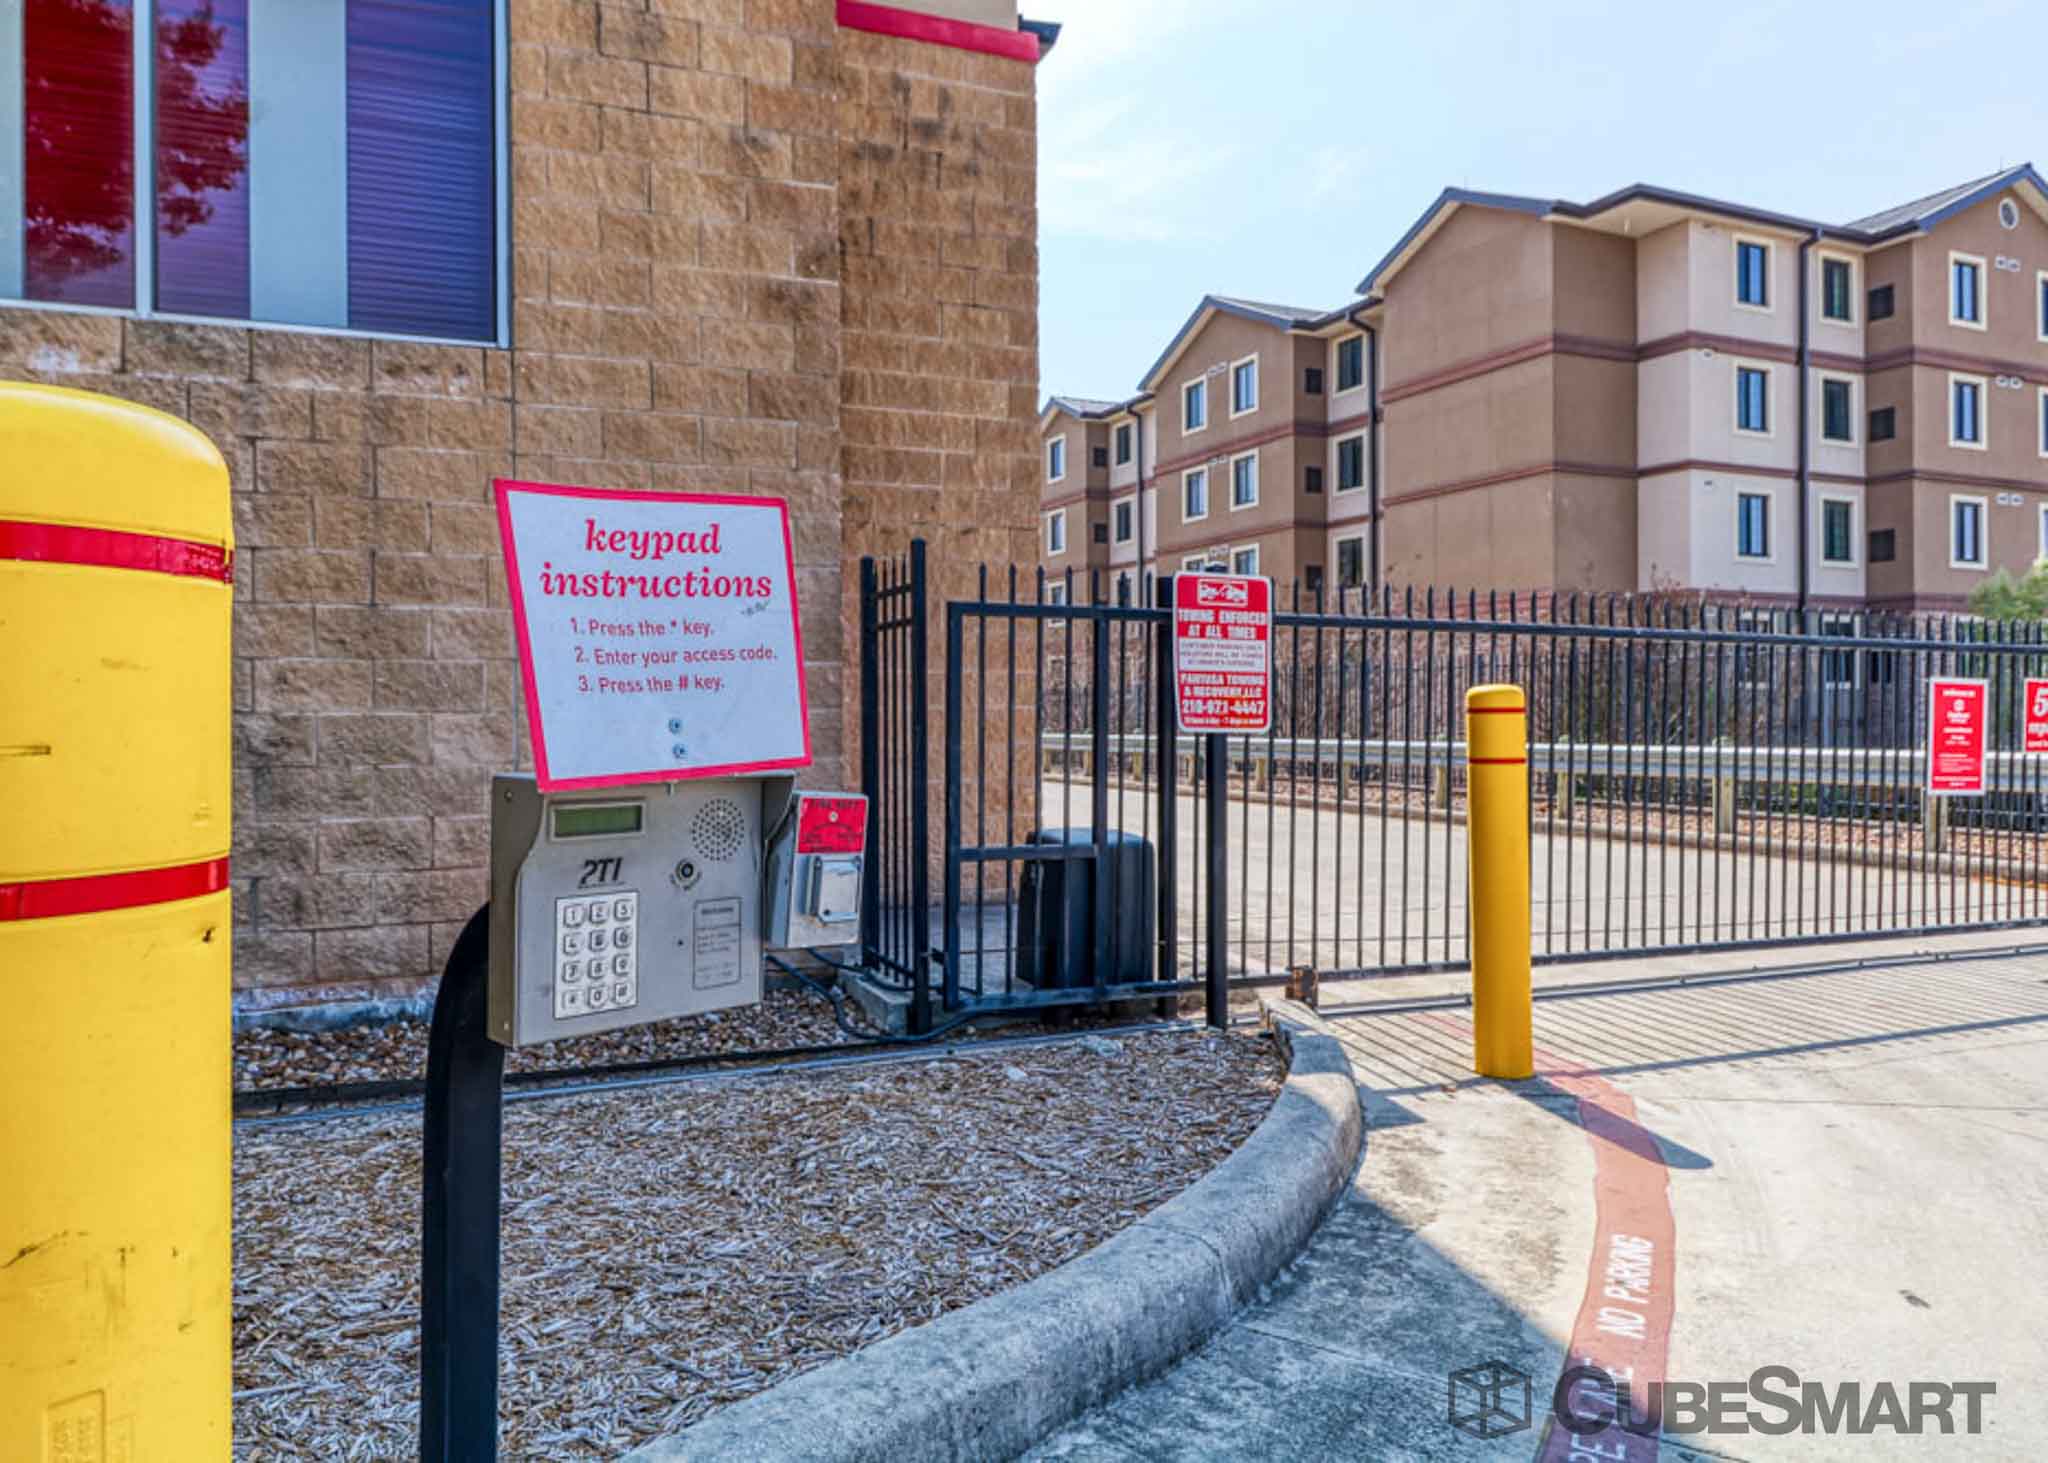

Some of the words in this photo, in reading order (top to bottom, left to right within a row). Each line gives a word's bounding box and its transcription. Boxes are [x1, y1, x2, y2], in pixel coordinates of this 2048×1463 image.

[585, 518, 722, 560] keypad
[539, 562, 773, 598] instructions
[570, 617, 584, 635] 1.
[589, 619, 635, 637] Press
[638, 619, 665, 635] the
[683, 619, 715, 639] key.
[574, 646, 590, 663] 2.
[594, 648, 636, 665] Enter
[641, 649, 677, 669] your
[683, 648, 735, 663] access
[739, 644, 777, 662] code.
[578, 674, 592, 693] 3.
[599, 676, 643, 694] Press
[646, 676, 672, 692] the
[678, 676, 689, 690] #
[694, 674, 724, 693] key.
[1603, 1232, 1656, 1305] PARKING
[1597, 1305, 1647, 1341] NO
